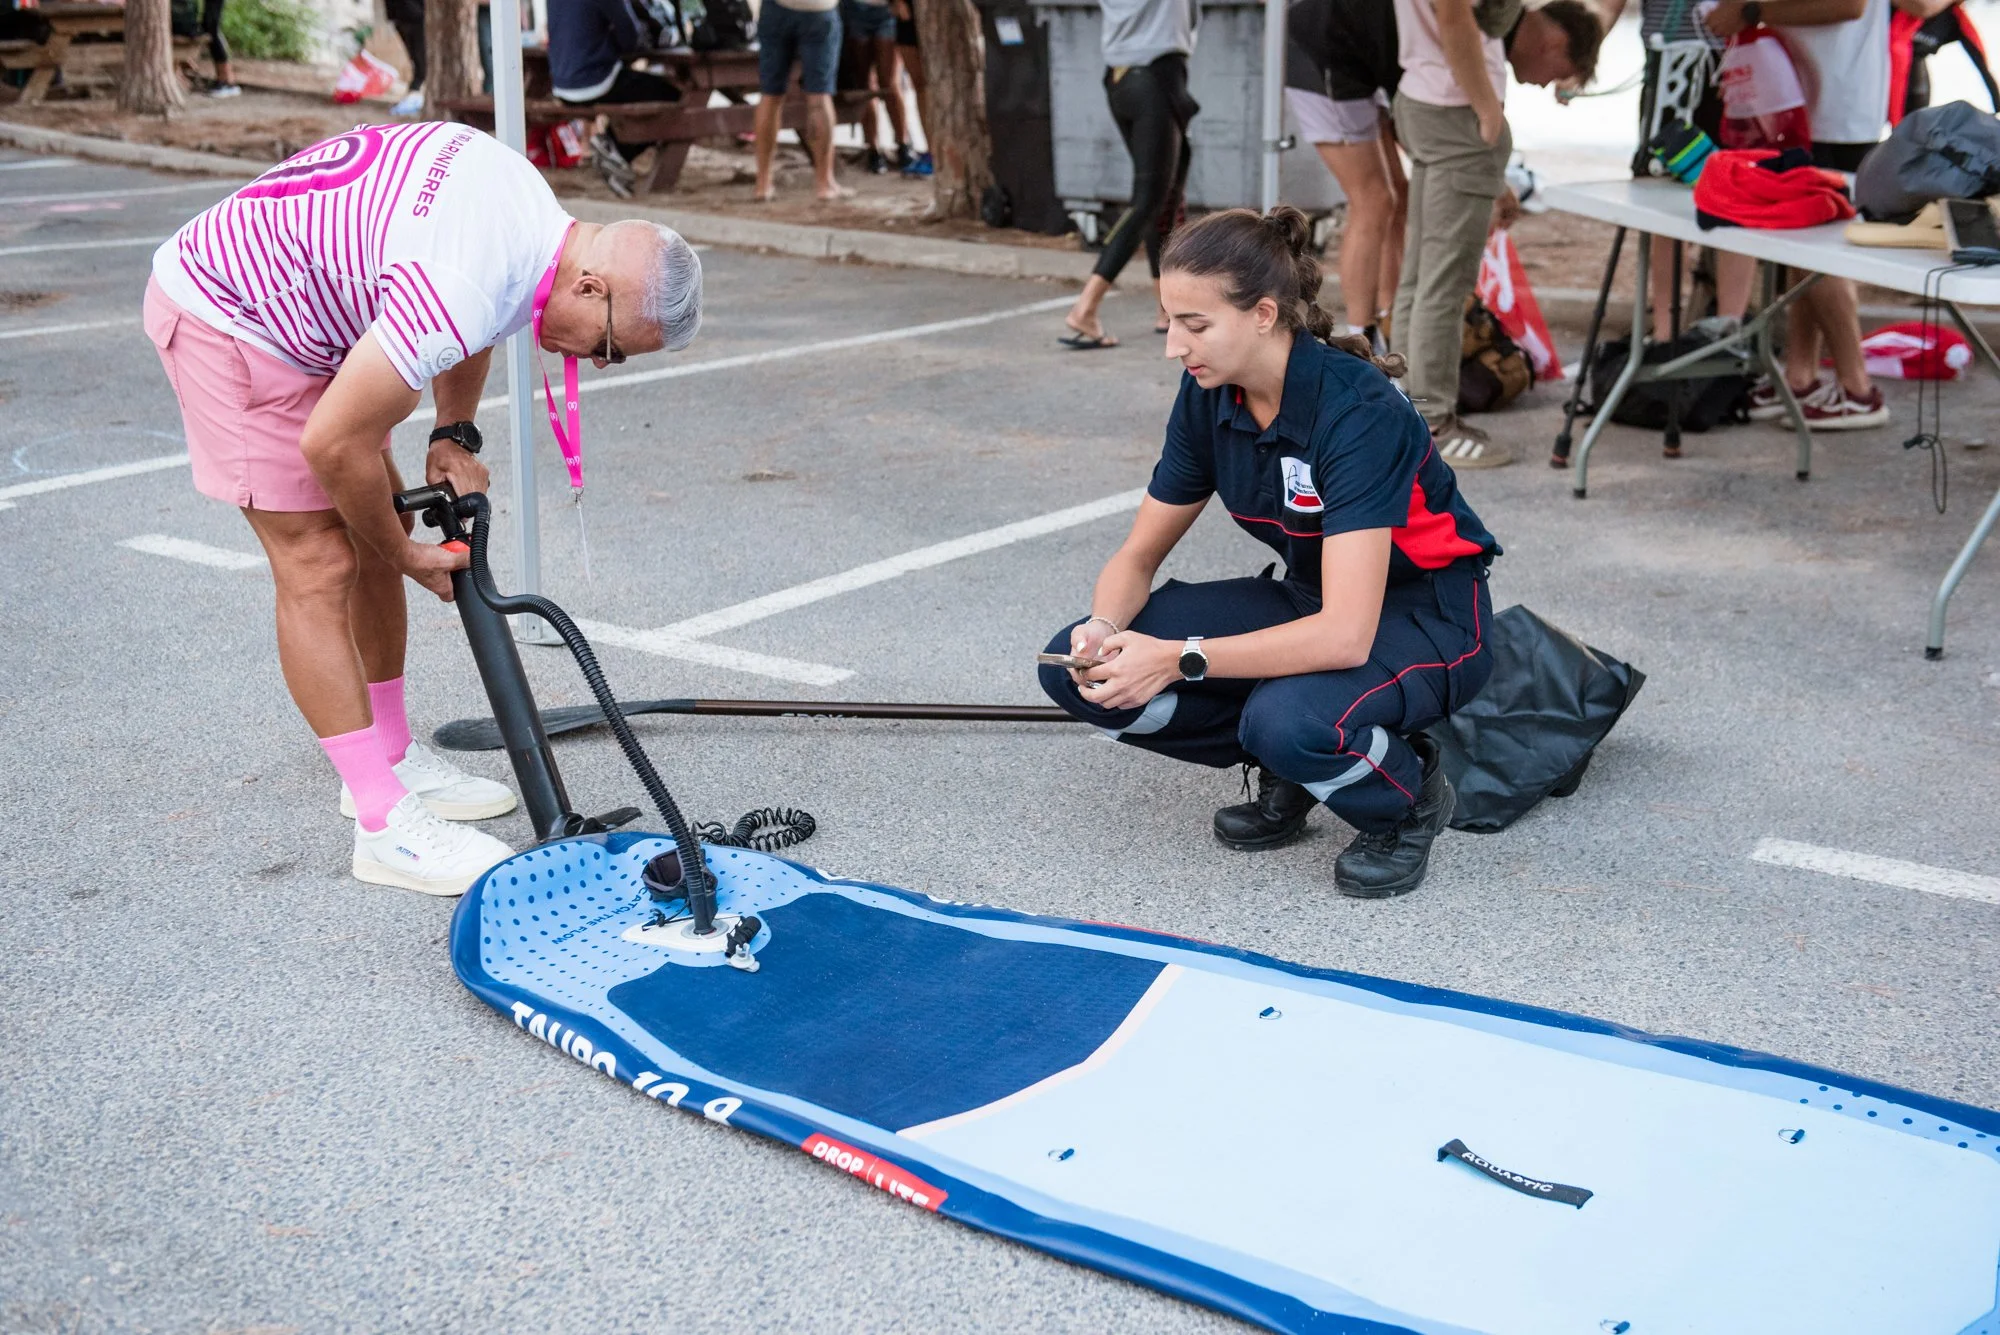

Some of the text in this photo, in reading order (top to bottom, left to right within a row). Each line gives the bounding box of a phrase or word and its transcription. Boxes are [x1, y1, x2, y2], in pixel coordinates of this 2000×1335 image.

[551, 886, 649, 945] CATCH THE FLOW
[812, 1141, 865, 1173] DROP
